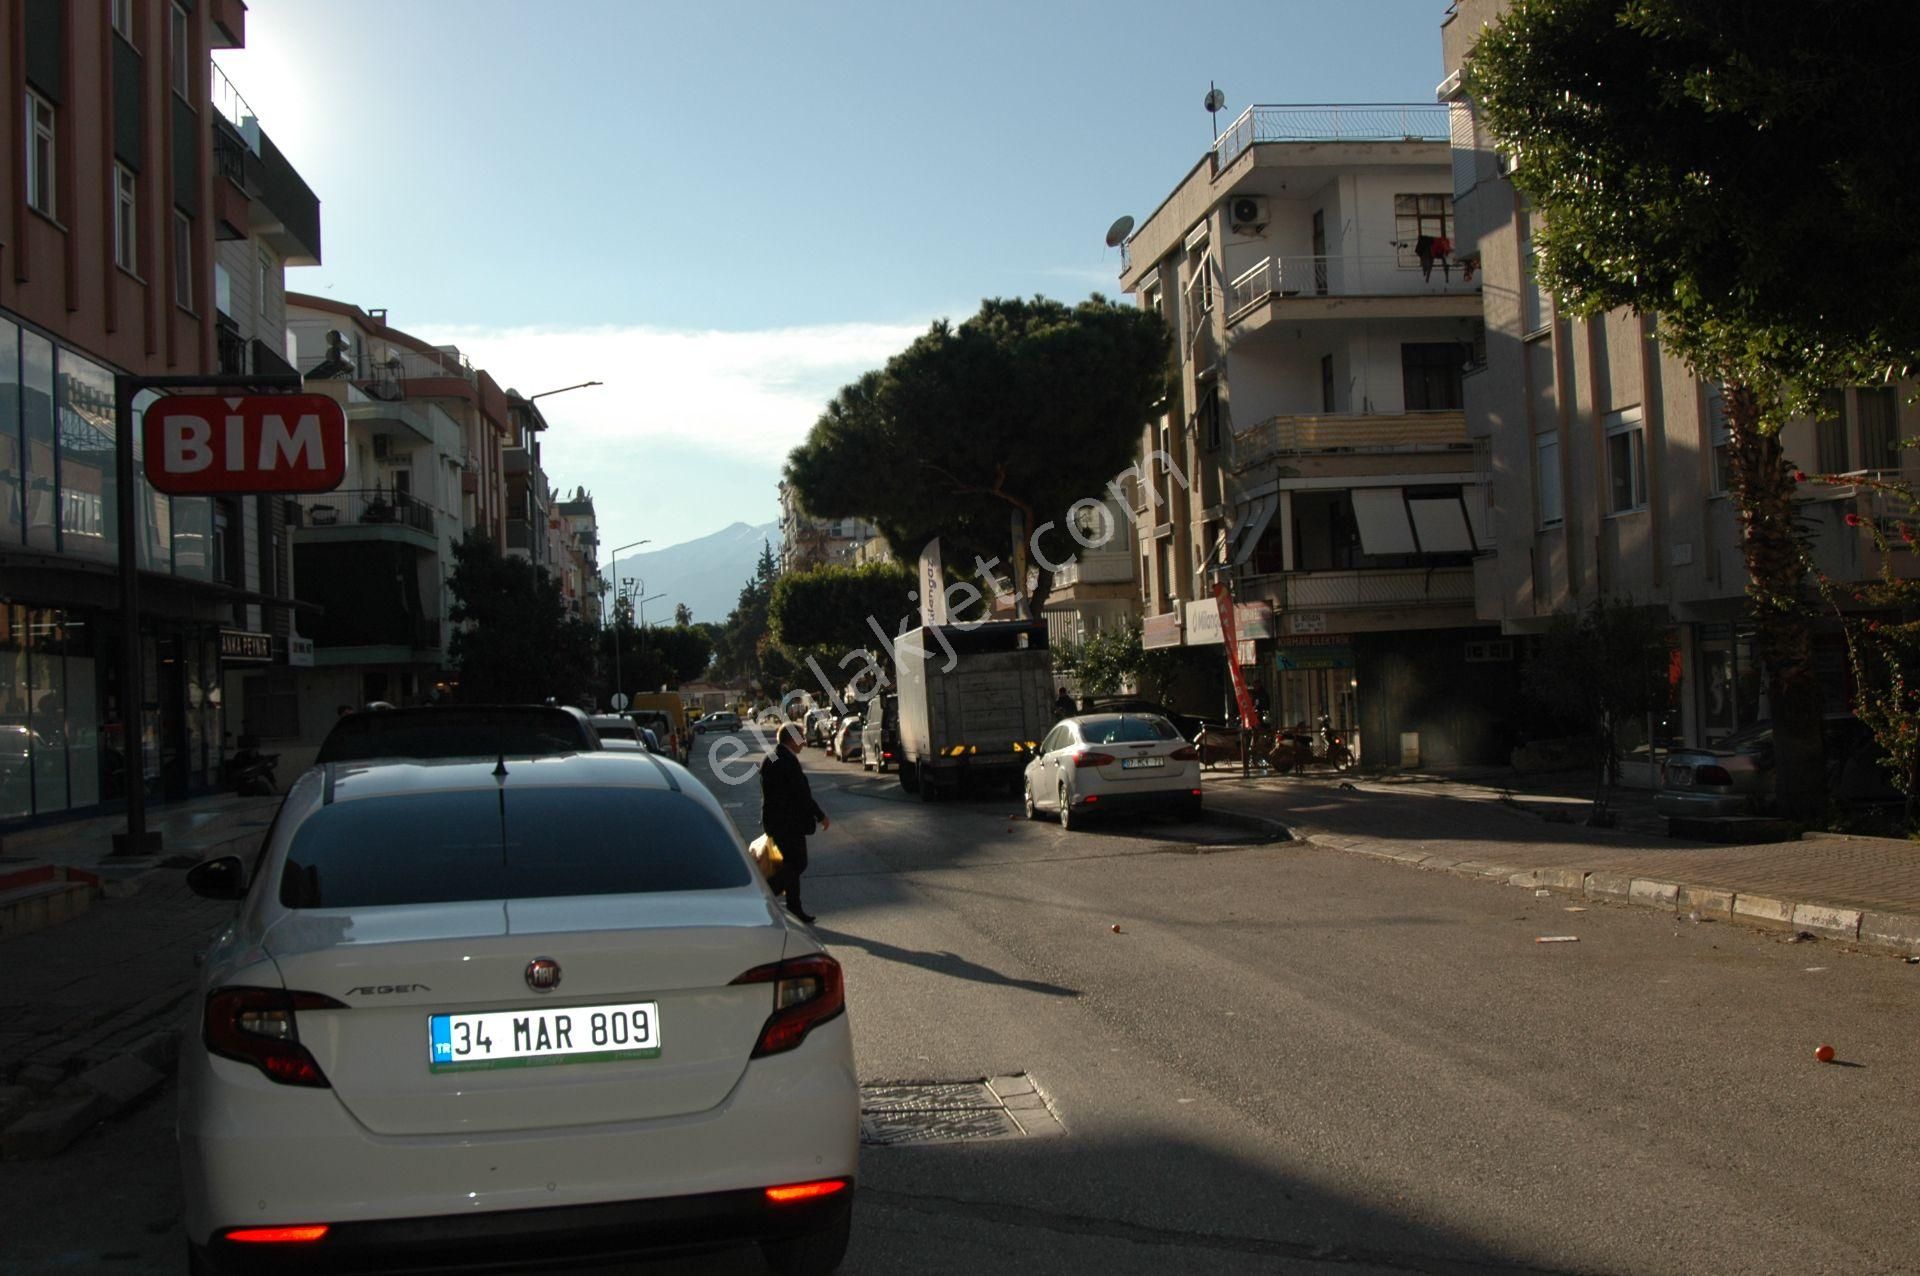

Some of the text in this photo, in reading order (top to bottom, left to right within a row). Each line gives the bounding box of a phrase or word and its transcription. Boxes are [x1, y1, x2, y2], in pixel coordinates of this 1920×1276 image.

[163, 397, 326, 473] BİM
[533, 966, 554, 983] FIAT
[435, 1009, 650, 1056] TR 34 MAR 809
